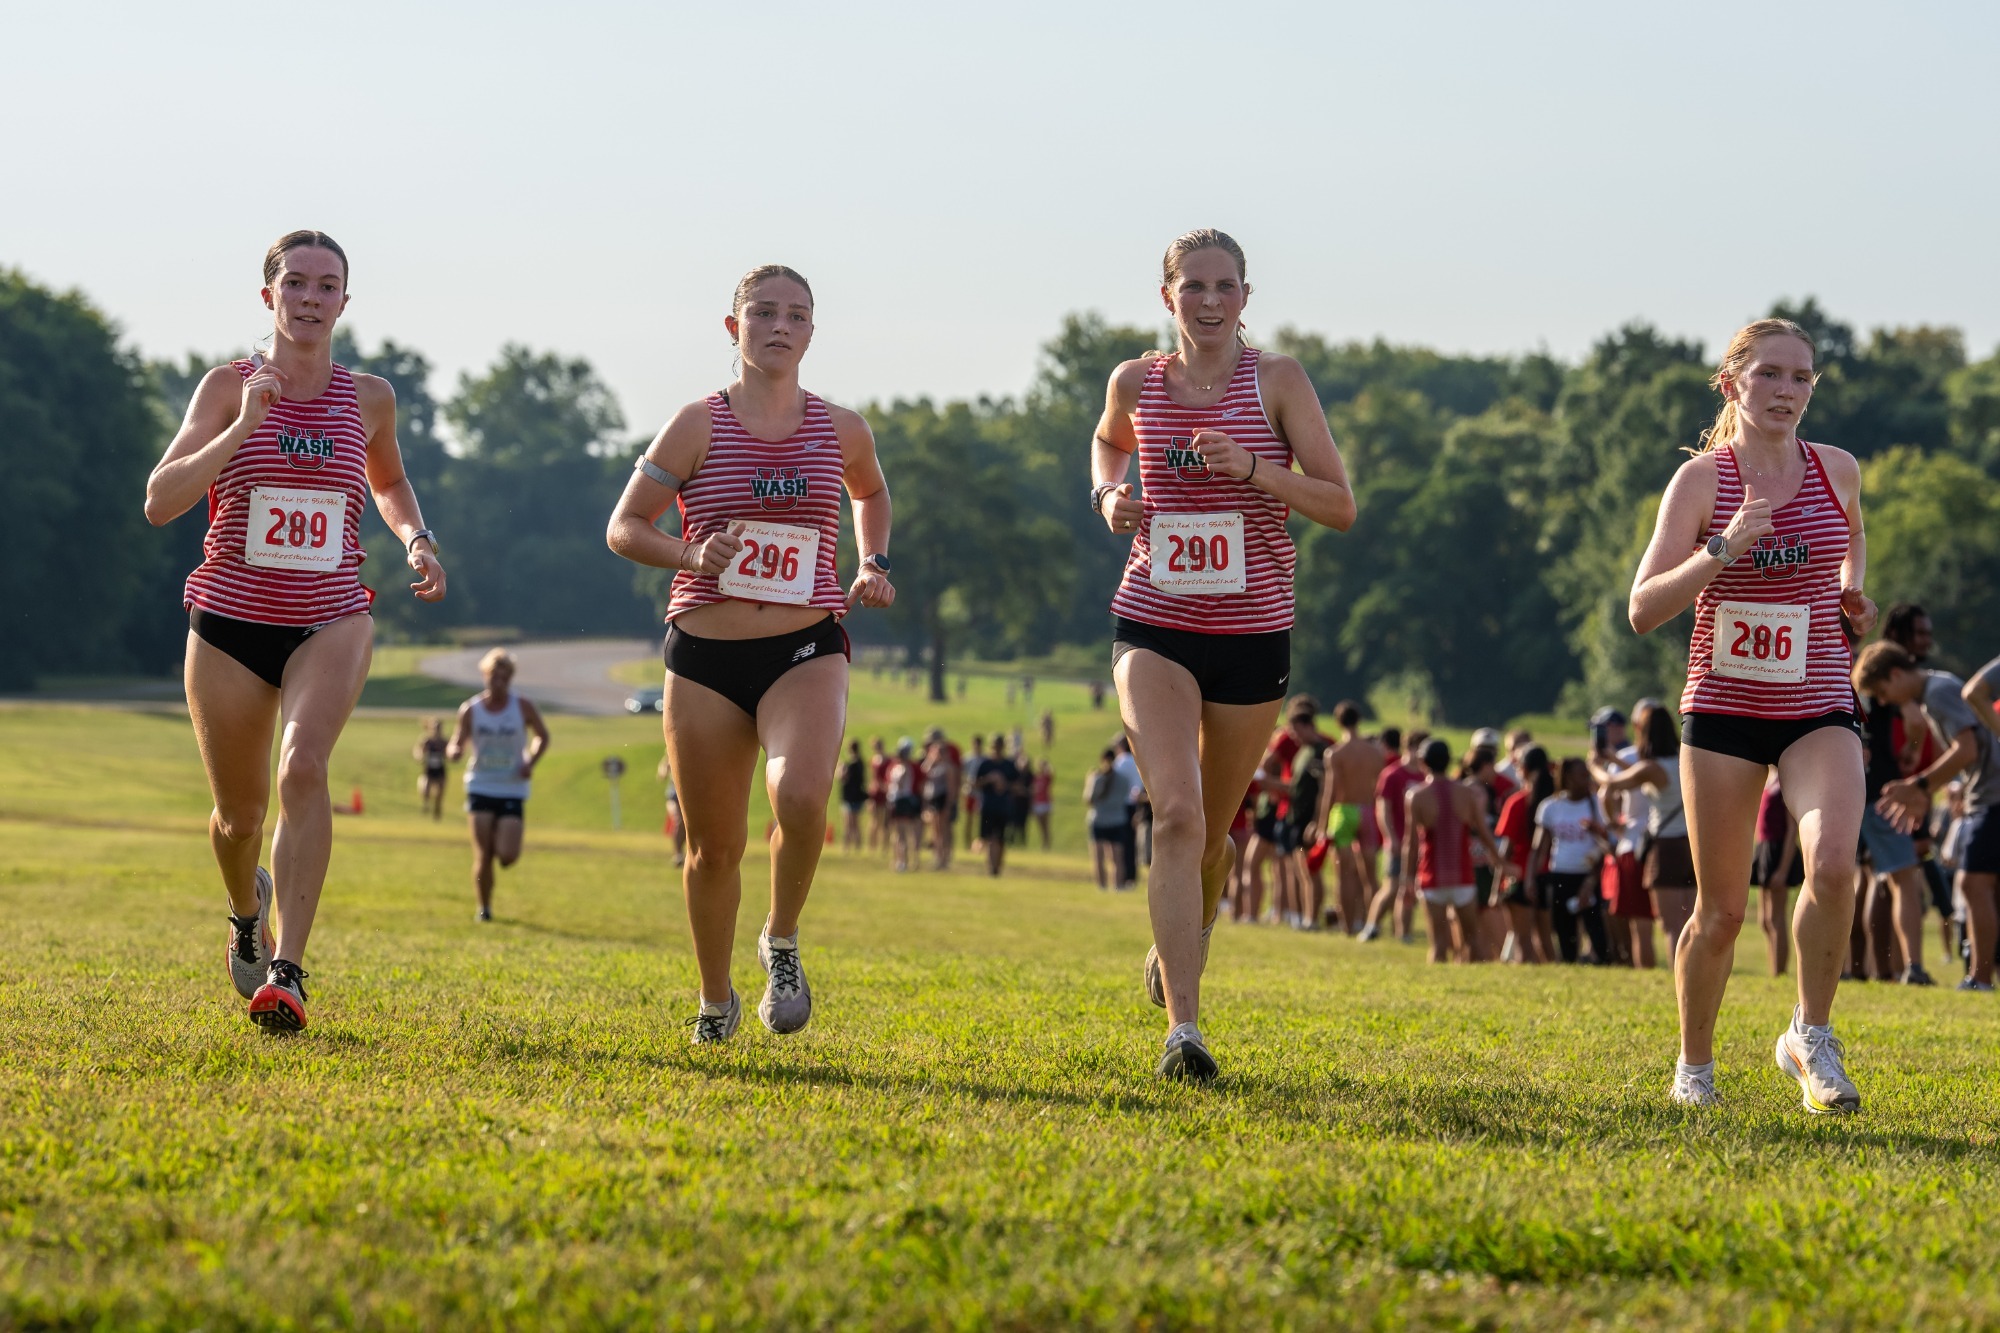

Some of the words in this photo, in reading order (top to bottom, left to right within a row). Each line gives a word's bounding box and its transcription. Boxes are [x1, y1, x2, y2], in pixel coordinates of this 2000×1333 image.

[277, 434, 334, 458] WASH
[750, 477, 808, 499] WASH
[265, 507, 327, 549] 289
[756, 528, 770, 536] Red
[772, 530, 784, 538] Hot
[738, 539, 800, 582] 296
[1167, 535, 1229, 572] 290
[1751, 544, 1810, 570] WASH
[1730, 620, 1793, 661] 286
